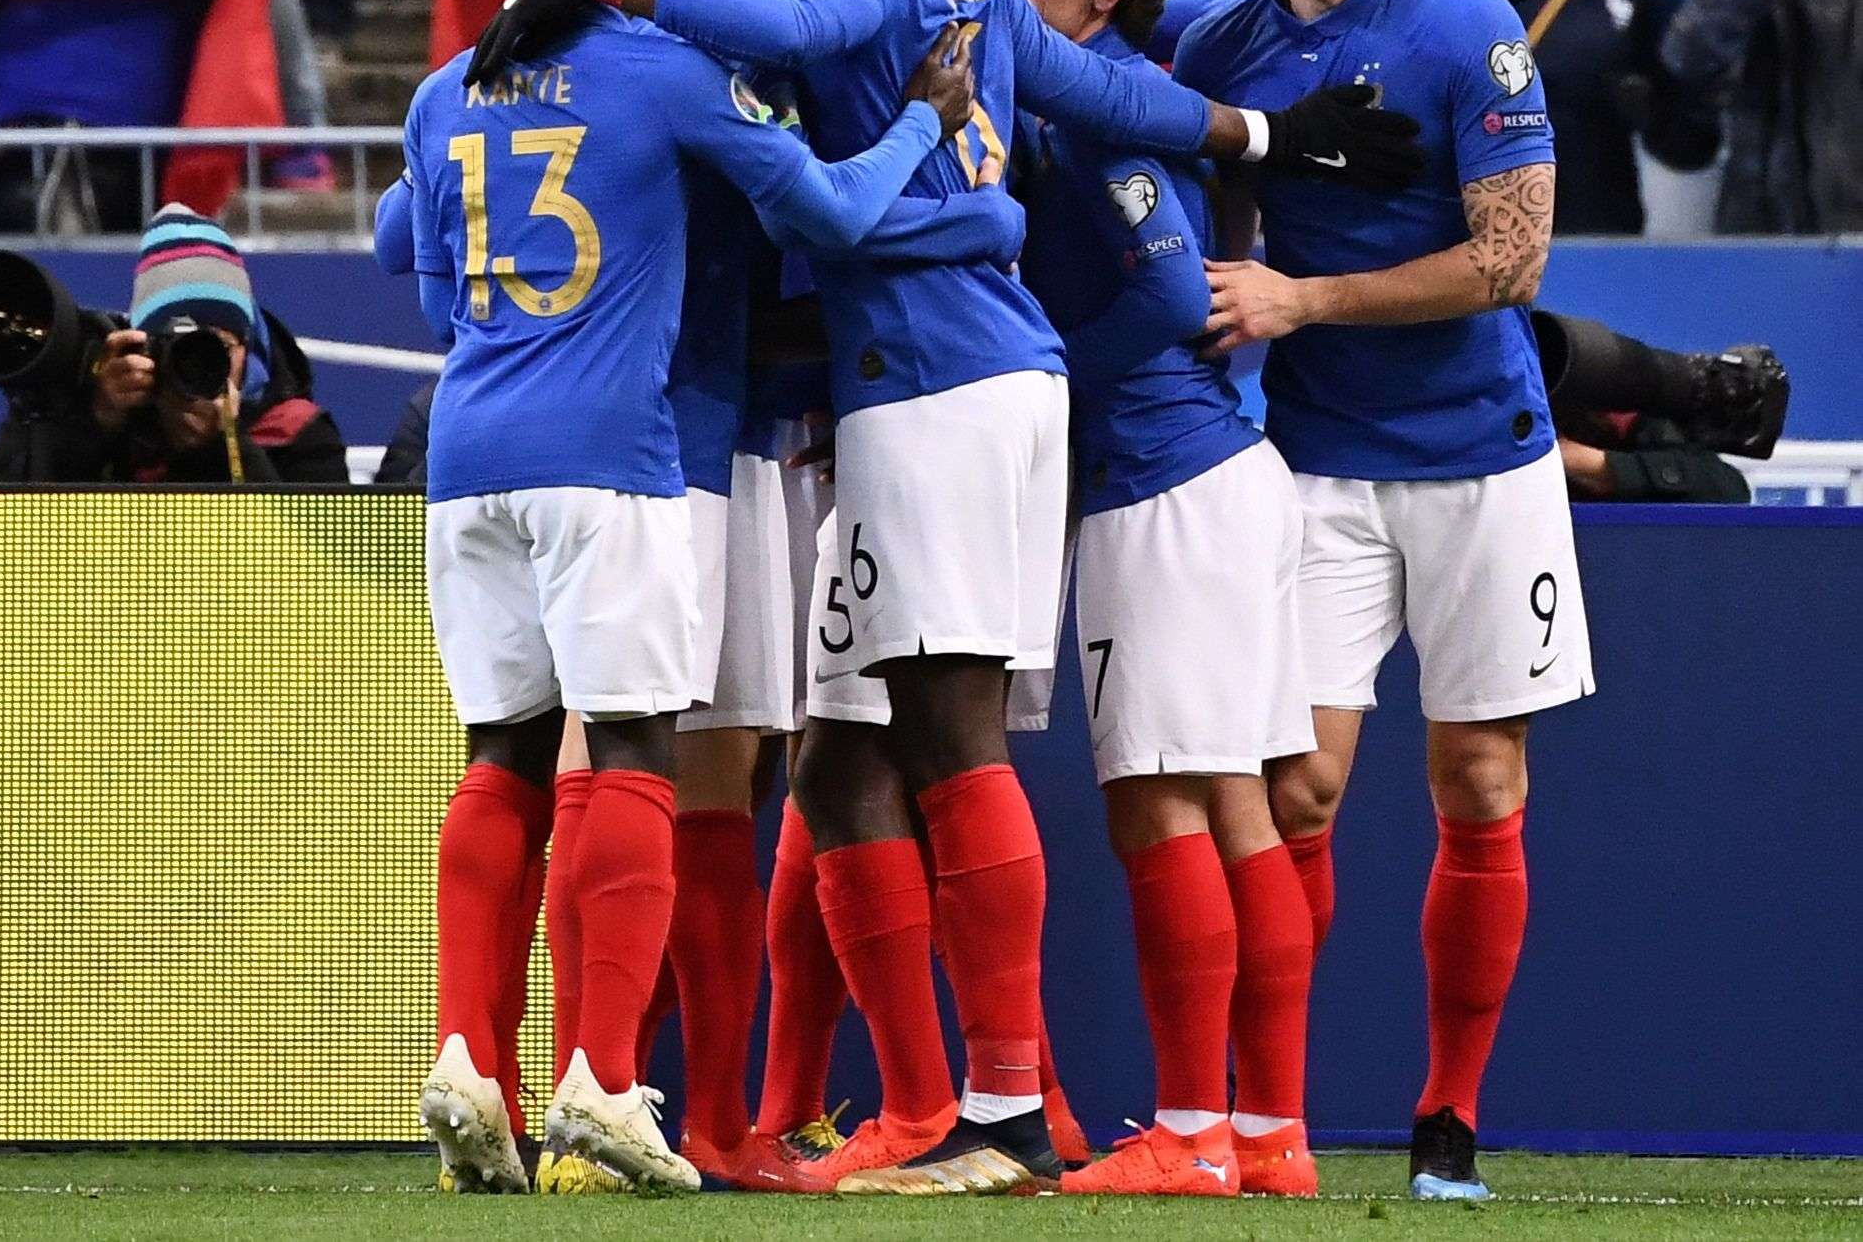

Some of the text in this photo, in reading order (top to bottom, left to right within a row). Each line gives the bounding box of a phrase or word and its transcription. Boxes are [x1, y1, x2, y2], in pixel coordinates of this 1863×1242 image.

[1503, 113, 1546, 127] RESPECT
[448, 126, 600, 321] 13
[850, 522, 878, 600] 6
[819, 576, 854, 654] 5
[1530, 572, 1557, 648] 9
[1087, 638, 1113, 719] 7
